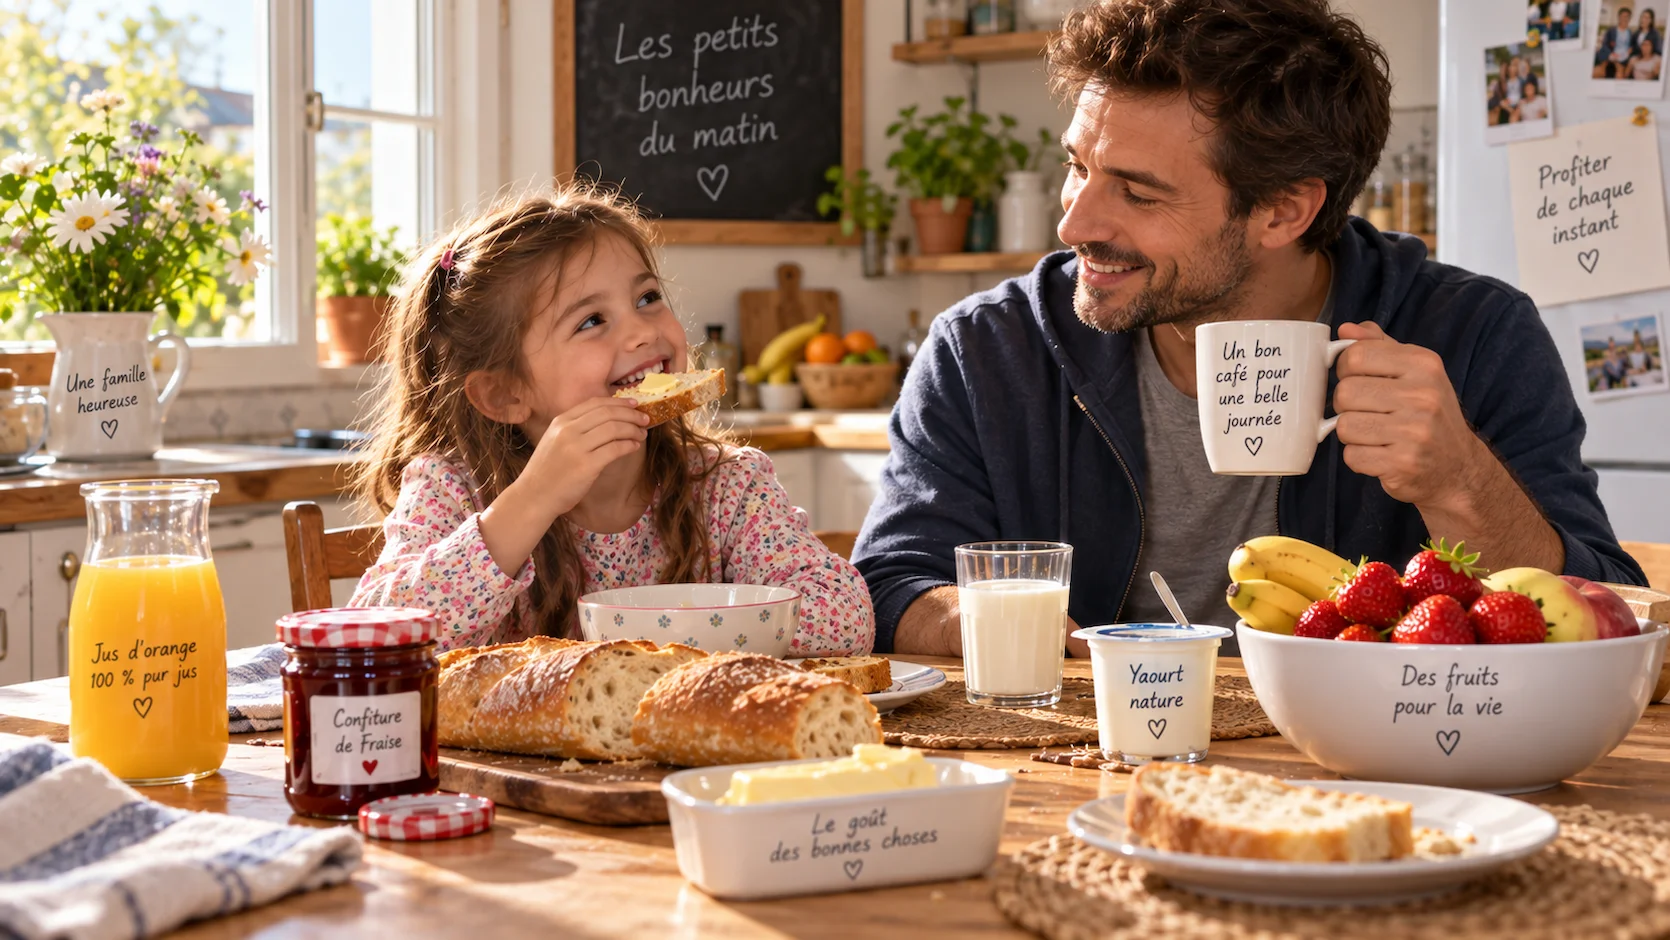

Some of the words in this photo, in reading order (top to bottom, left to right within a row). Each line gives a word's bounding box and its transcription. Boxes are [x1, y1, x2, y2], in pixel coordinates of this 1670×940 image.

[614, 23, 673, 64] Les
[692, 14, 779, 69] petits
[637, 71, 774, 113] bonheurs
[639, 120, 676, 156] du
[693, 113, 778, 149] matin
[1538, 155, 1612, 189] Profiter
[1536, 196, 1559, 219] de
[1568, 181, 1635, 212] chaque
[1553, 210, 1619, 244] instant
[1223, 341, 1246, 360] Un
[1254, 340, 1282, 357] bon
[66, 373, 95, 392] Une
[102, 364, 147, 392] famille
[1215, 363, 1248, 387] café
[1255, 368, 1292, 388] pour
[77, 396, 139, 413] heureuse
[1219, 394, 1245, 406] une
[1254, 384, 1289, 404] belle
[1223, 410, 1282, 434] journée
[91, 643, 119, 664] Jus
[128, 638, 197, 663] d'orange
[91, 672, 115, 688] 100
[121, 669, 135, 685] %
[142, 671, 170, 691] pur
[172, 665, 198, 688] jus
[1129, 664, 1184, 684] Yaourt
[1401, 665, 1437, 686] Des
[1445, 663, 1499, 692] fruits
[1129, 692, 1184, 708] nature
[1392, 702, 1437, 723] pour
[1446, 693, 1464, 715] la
[1476, 697, 1503, 715] vie
[333, 707, 402, 732] Confiture
[334, 736, 353, 753] de
[360, 733, 403, 753] Fraise
[811, 814, 836, 835] Le
[846, 807, 888, 837] goût
[769, 842, 800, 862] des
[811, 838, 871, 858] bonnes
[881, 828, 938, 849] choses
